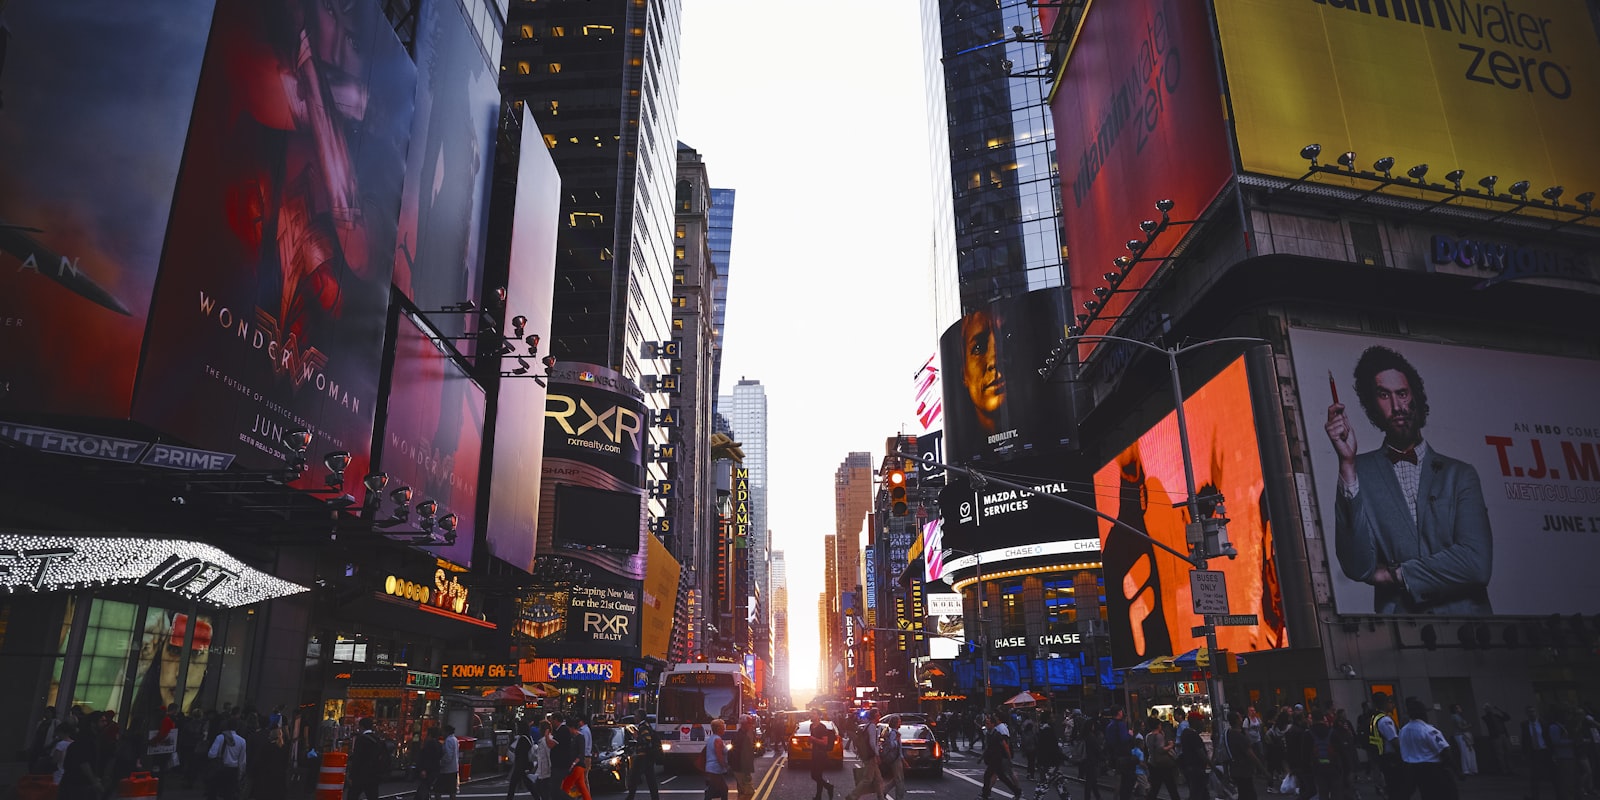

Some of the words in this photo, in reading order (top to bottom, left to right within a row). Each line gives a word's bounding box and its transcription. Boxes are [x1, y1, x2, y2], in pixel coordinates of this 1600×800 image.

[1458, 43, 1572, 99] zero
[1133, 47, 1180, 155] zero
[199, 290, 292, 369] WONDER
[302, 361, 360, 414] WOMAN
[204, 364, 220, 379] THE
[223, 375, 251, 397] FUTURE
[253, 392, 263, 402] OF
[265, 400, 292, 419] JUSTICE
[251, 413, 284, 444] JUN
[545, 394, 640, 451] RXR
[1514, 423, 1530, 432] AN
[1534, 424, 1561, 435] HBO
[988, 429, 1019, 444] EQUALITY.
[392, 432, 437, 476] WONDER
[567, 437, 621, 454] rxrrealty.com
[154, 447, 224, 470] PRIME
[1485, 435, 1560, 479] T.J.
[1560, 441, 1600, 481] M
[542, 467, 580, 475] SHARP
[736, 468, 748, 536] MADAME
[983, 490, 1017, 505] MAZDA
[984, 500, 1029, 517] SERVICES
[1543, 515, 1586, 533] JUNE
[1005, 547, 1033, 558] CHASE
[1074, 541, 1100, 550] CHAS
[1196, 574, 1219, 582] BUSES
[607, 587, 623, 598] New
[623, 590, 635, 600] York
[1200, 583, 1217, 591] ONLY
[571, 597, 585, 607] for
[586, 598, 600, 608] the
[600, 600, 614, 609] 21st
[614, 601, 636, 614] Century
[913, 580, 923, 618] VICTORY
[583, 612, 629, 635] RXR
[1223, 616, 1256, 625] Broadway
[914, 622, 924, 641] NW
[1039, 633, 1081, 646] CHASE
[845, 616, 855, 668] REGAL
[994, 636, 1026, 649] CHASE
[452, 665, 485, 678] KNOW
[548, 663, 613, 679] CHAMPS
[1178, 682, 1200, 694] SODA
